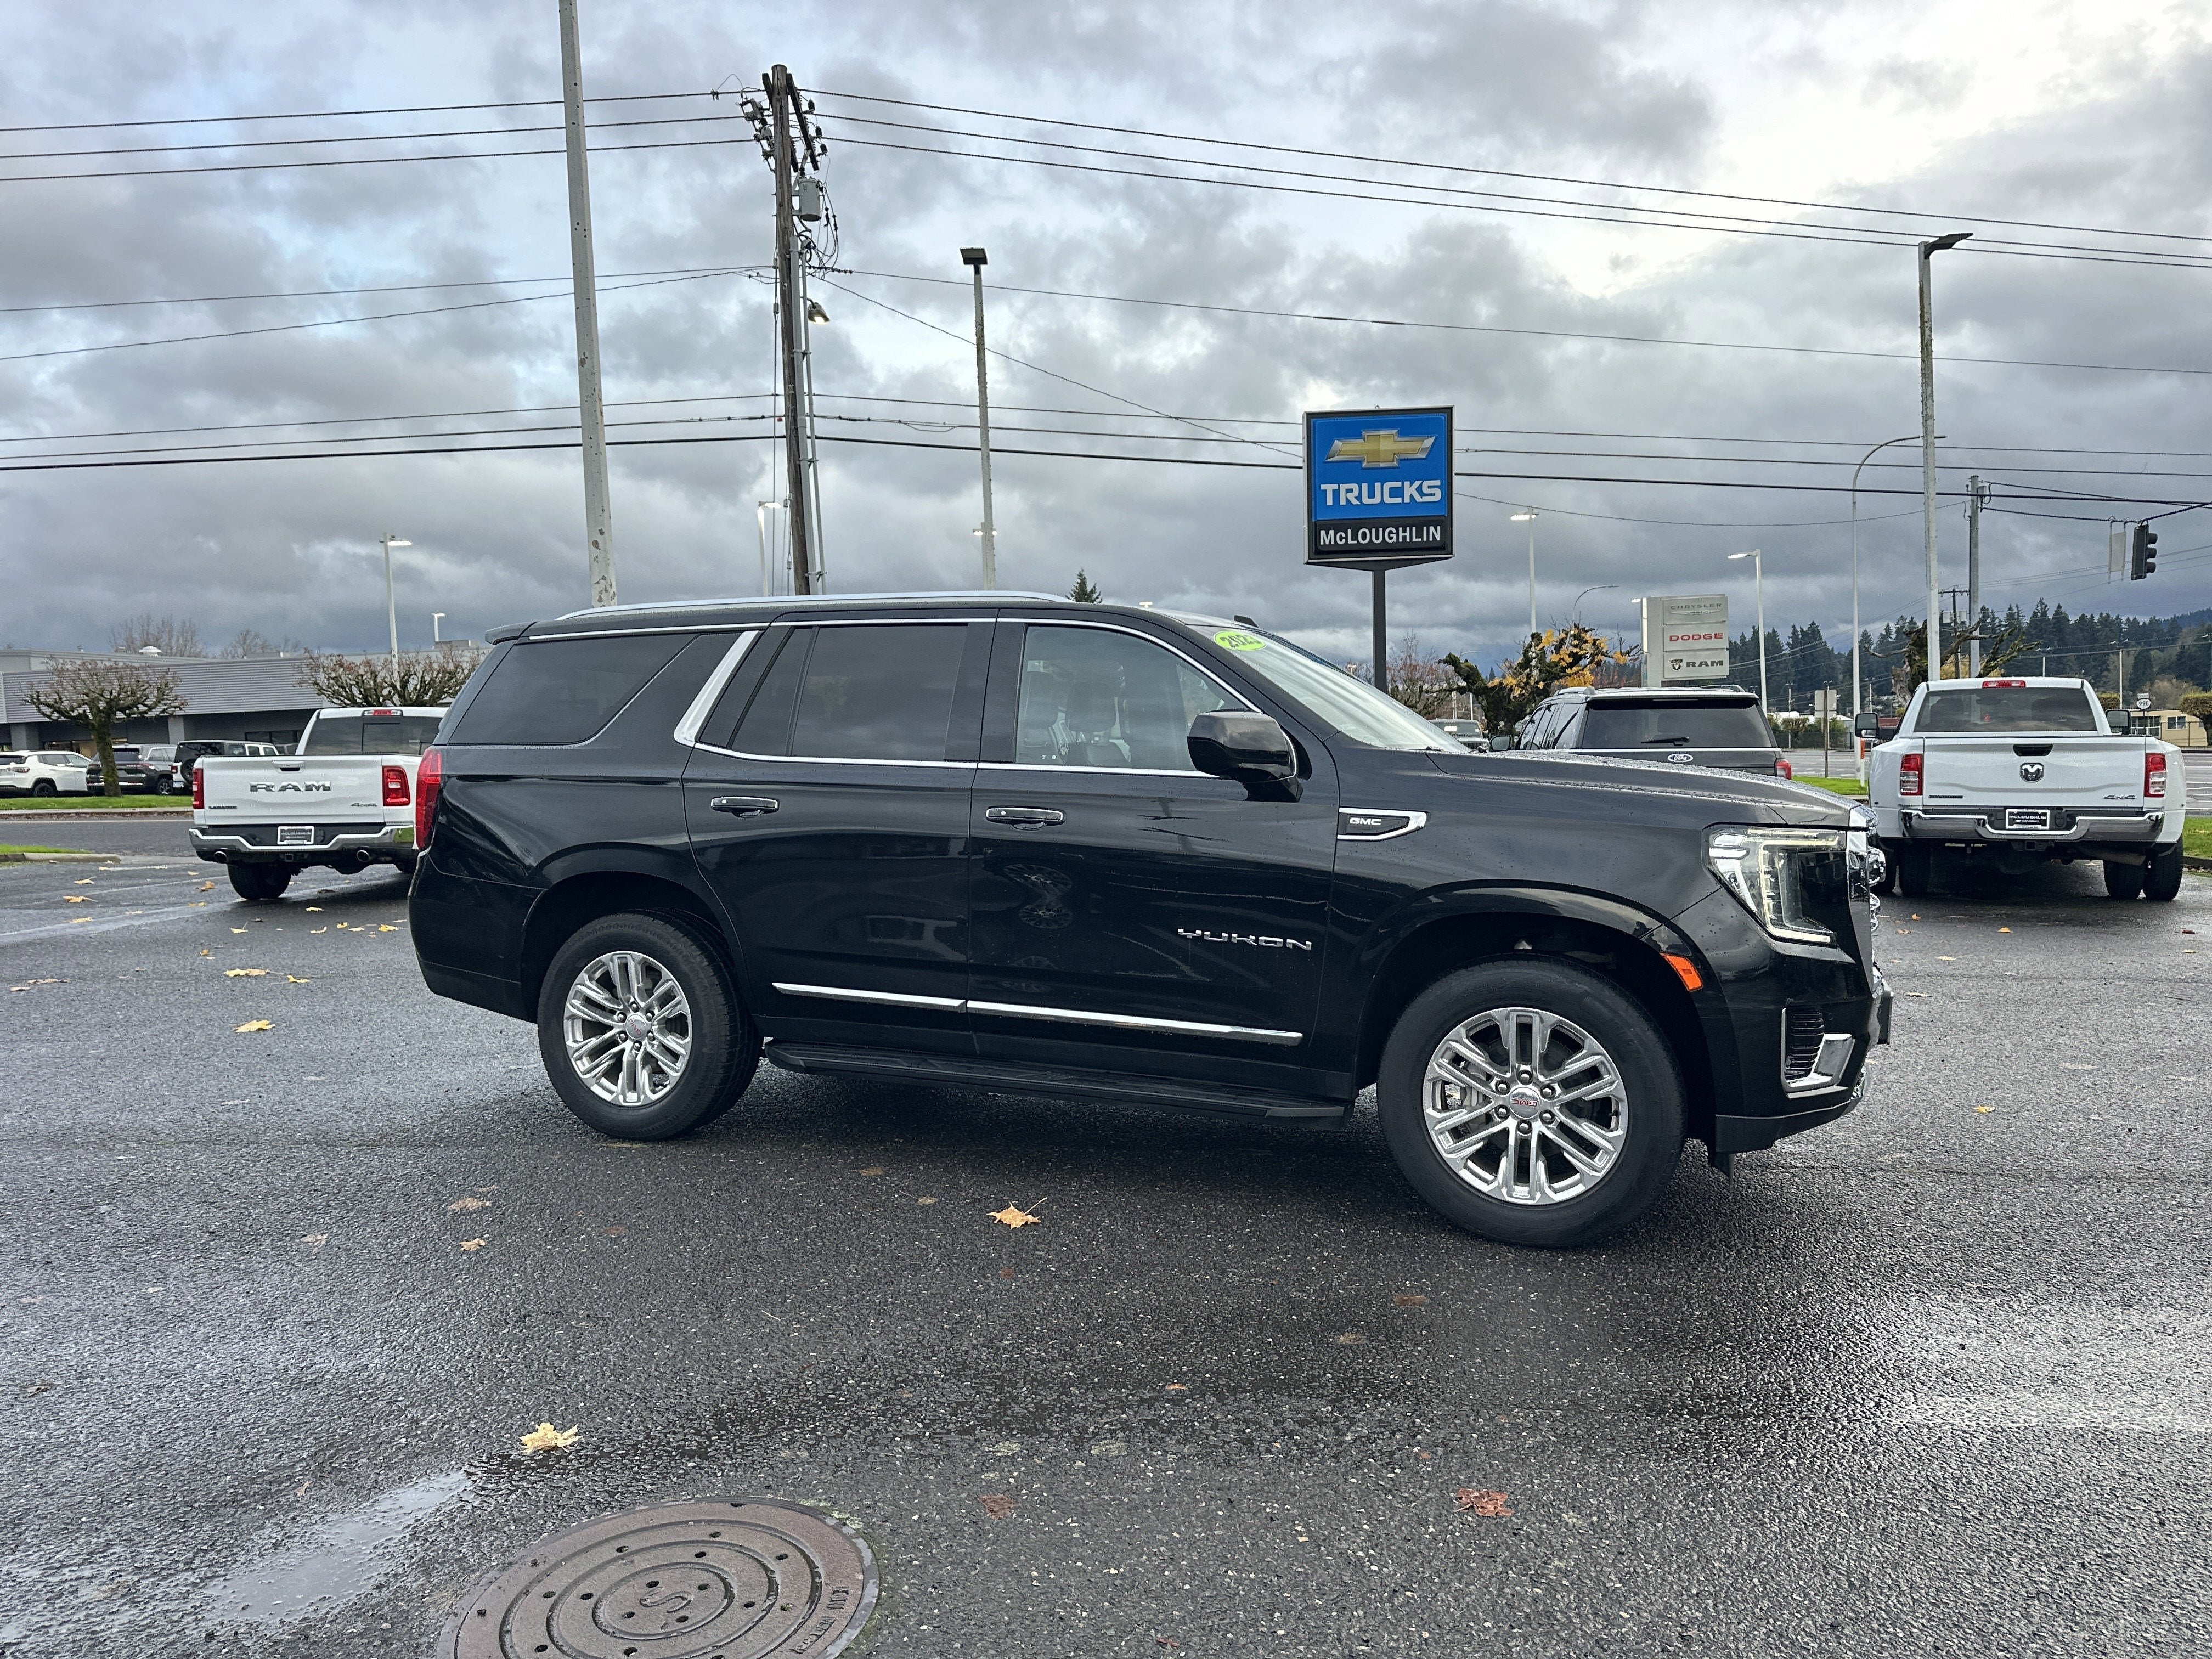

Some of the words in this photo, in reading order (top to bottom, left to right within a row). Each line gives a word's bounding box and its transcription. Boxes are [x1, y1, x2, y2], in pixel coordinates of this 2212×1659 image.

[1320, 479, 1441, 506] TRUCKS
[1320, 526, 1441, 545] McLOUGHLIN
[1669, 633, 1724, 641] DODGE
[250, 781, 331, 792] RAM
[1350, 817, 1381, 826] GMC
[1177, 928, 1312, 951] YUKON
[1511, 1098, 1538, 1107] GMC
